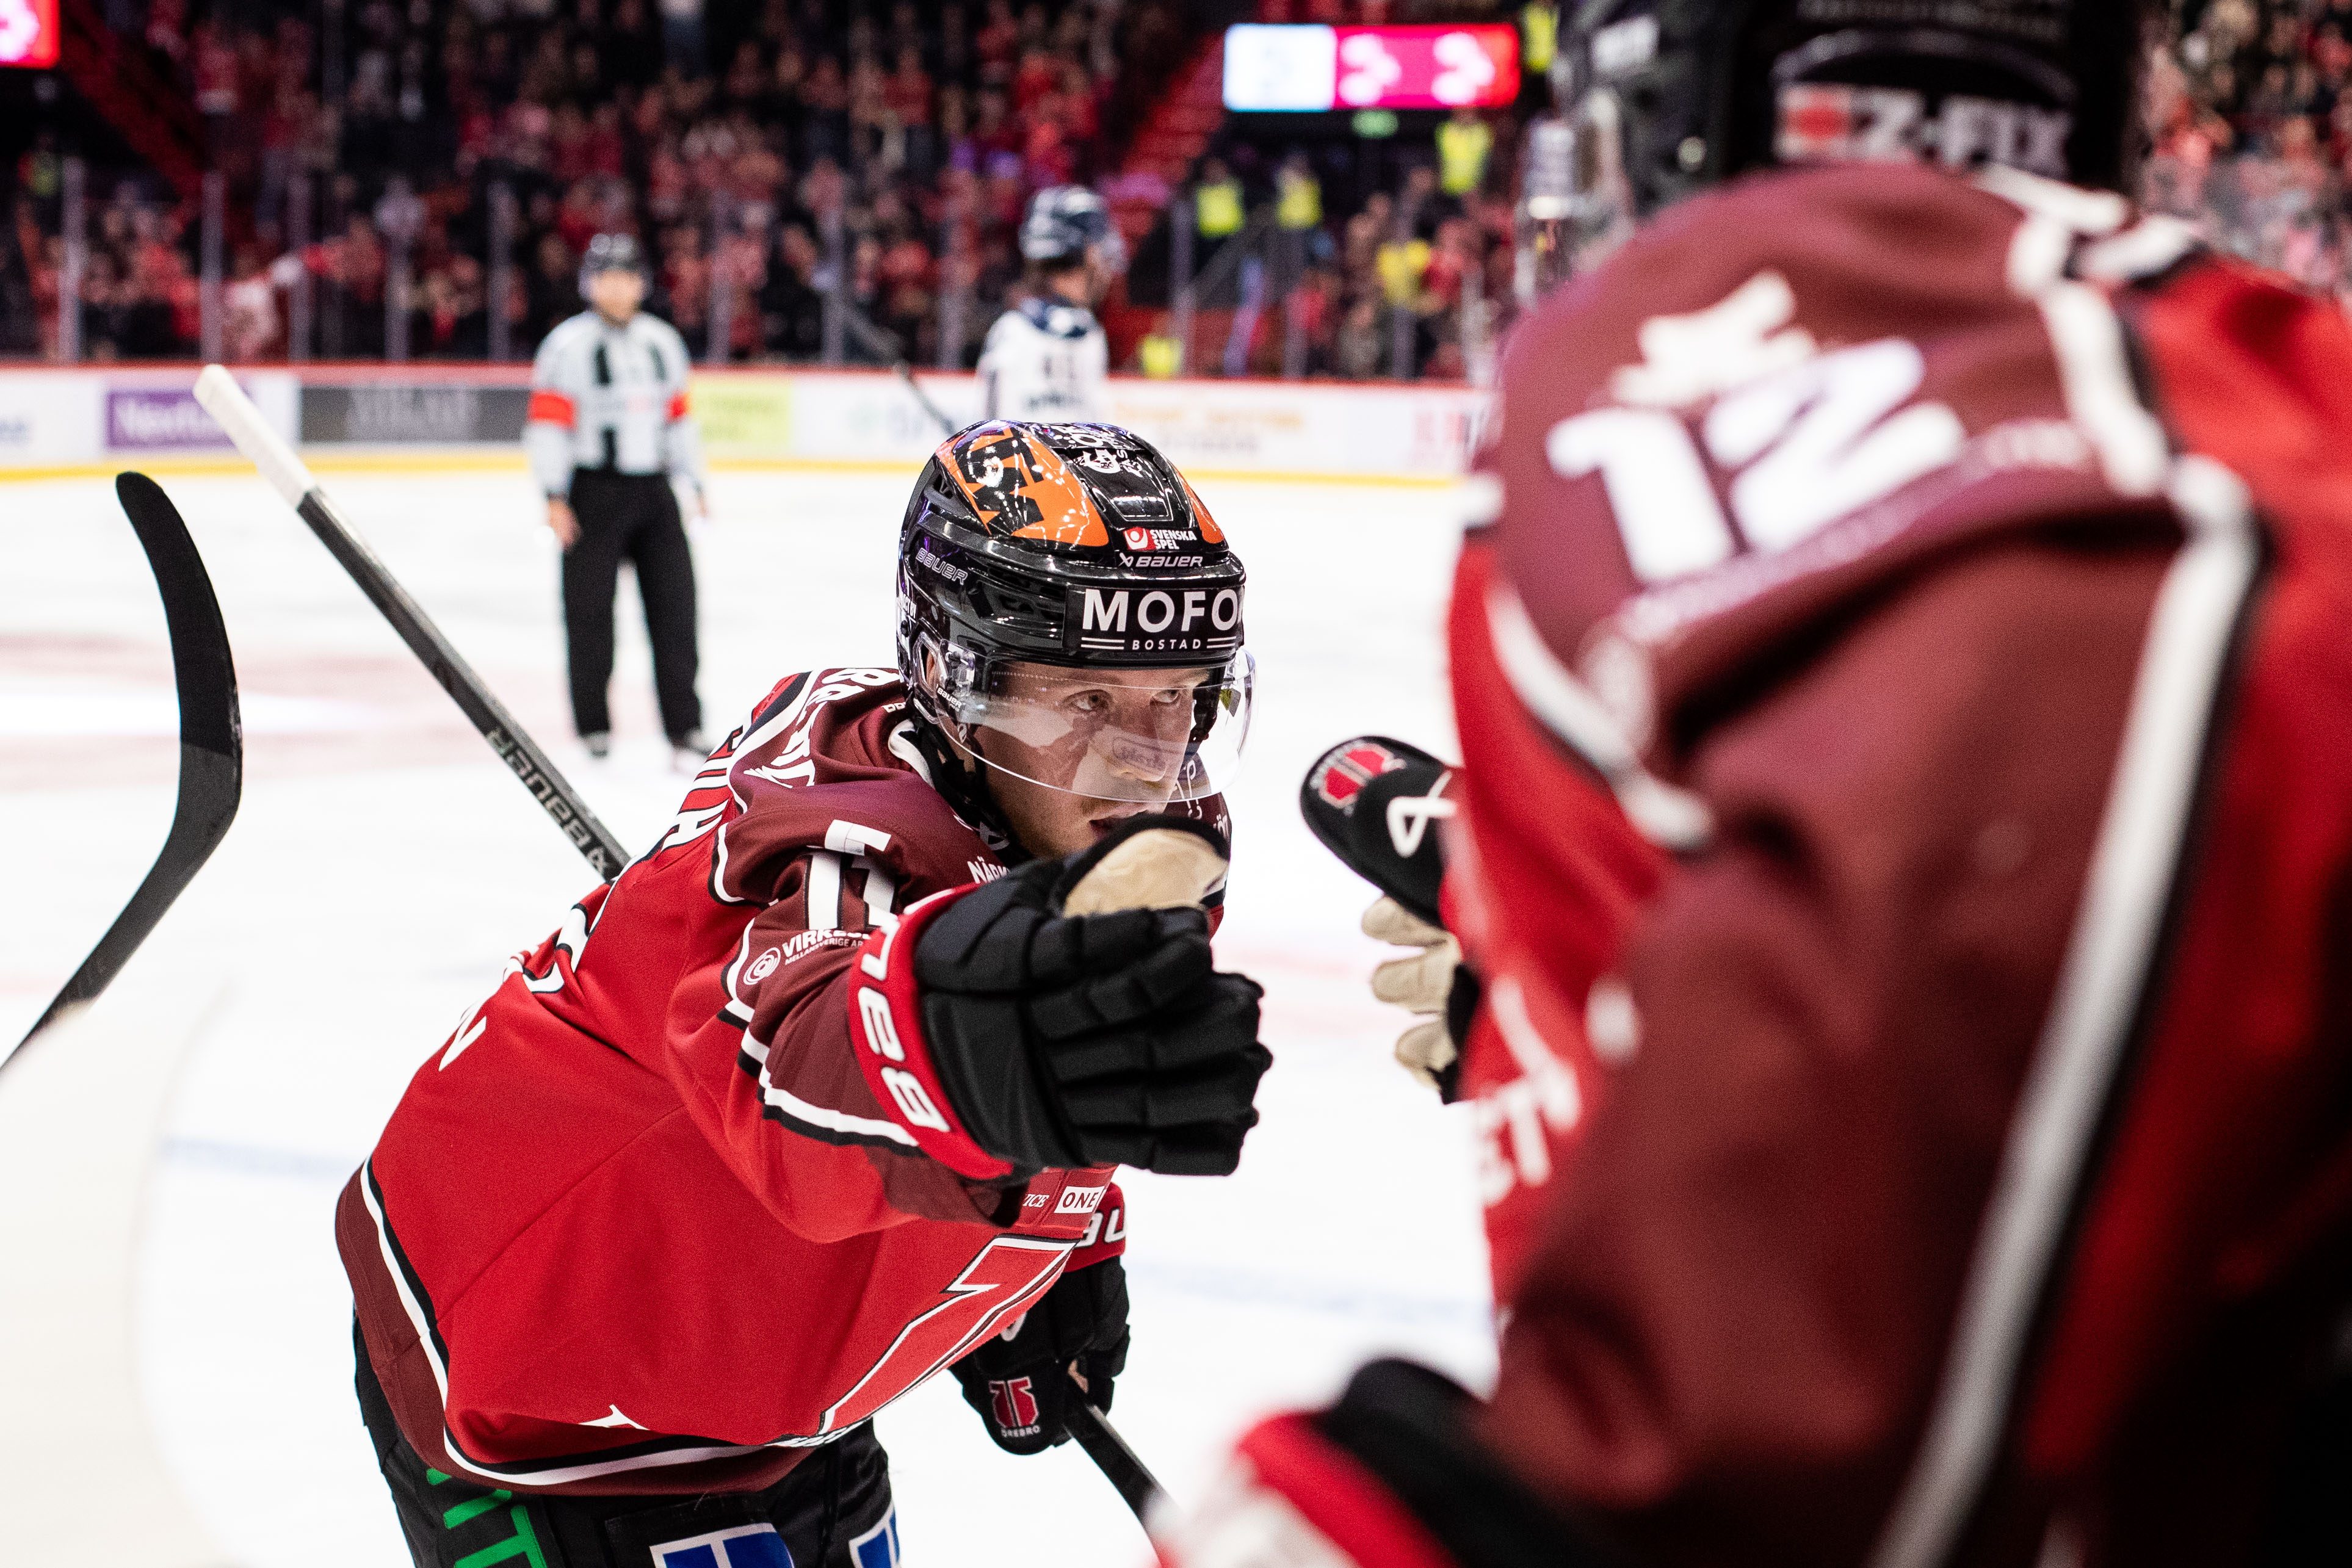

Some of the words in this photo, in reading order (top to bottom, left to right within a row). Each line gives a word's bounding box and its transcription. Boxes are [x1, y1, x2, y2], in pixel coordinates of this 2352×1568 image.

[1149, 529, 1197, 541] SVENSKA
[1153, 539, 1179, 550] SPEL
[916, 547, 968, 585] BAUER
[1135, 556, 1203, 568] BAUER
[1132, 639, 1201, 651] BOSTAD
[937, 687, 962, 708] BAUER
